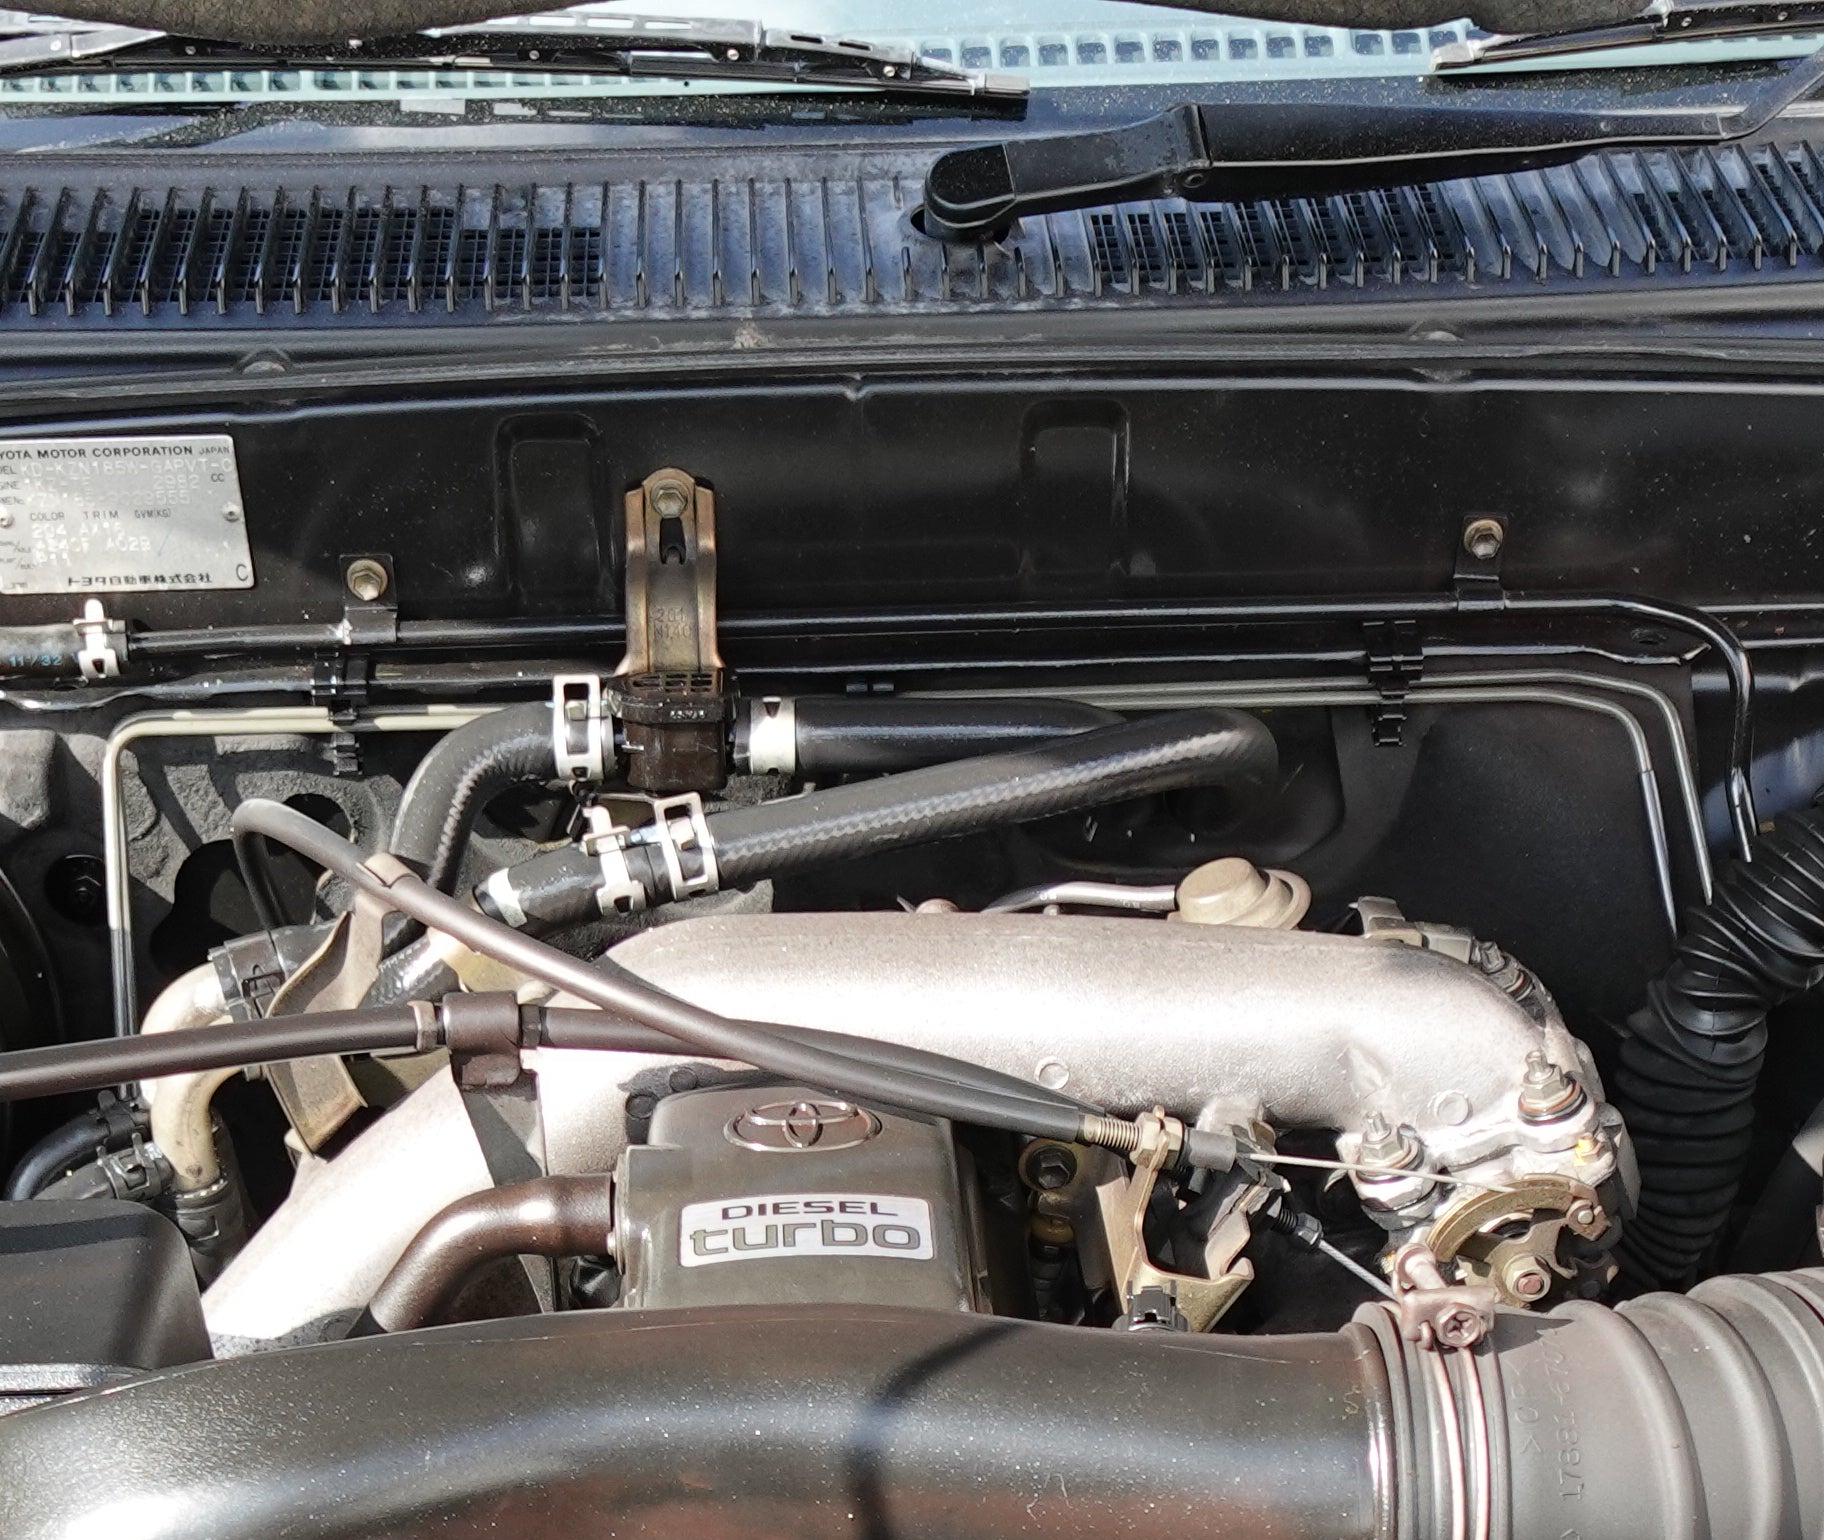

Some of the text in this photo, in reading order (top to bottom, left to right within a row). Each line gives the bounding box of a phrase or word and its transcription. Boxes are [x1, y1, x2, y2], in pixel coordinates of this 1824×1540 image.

[37, 448, 87, 459] MOTOR
[92, 446, 193, 458] CORPORATION
[199, 446, 230, 455] JAPAN
[30, 512, 65, 521] COLOR
[83, 510, 119, 520] TRIM
[68, 573, 213, 588] トヨタ自動車株式会社
[721, 1201, 899, 1220] DIESEL
[690, 1219, 921, 1257] turbo
